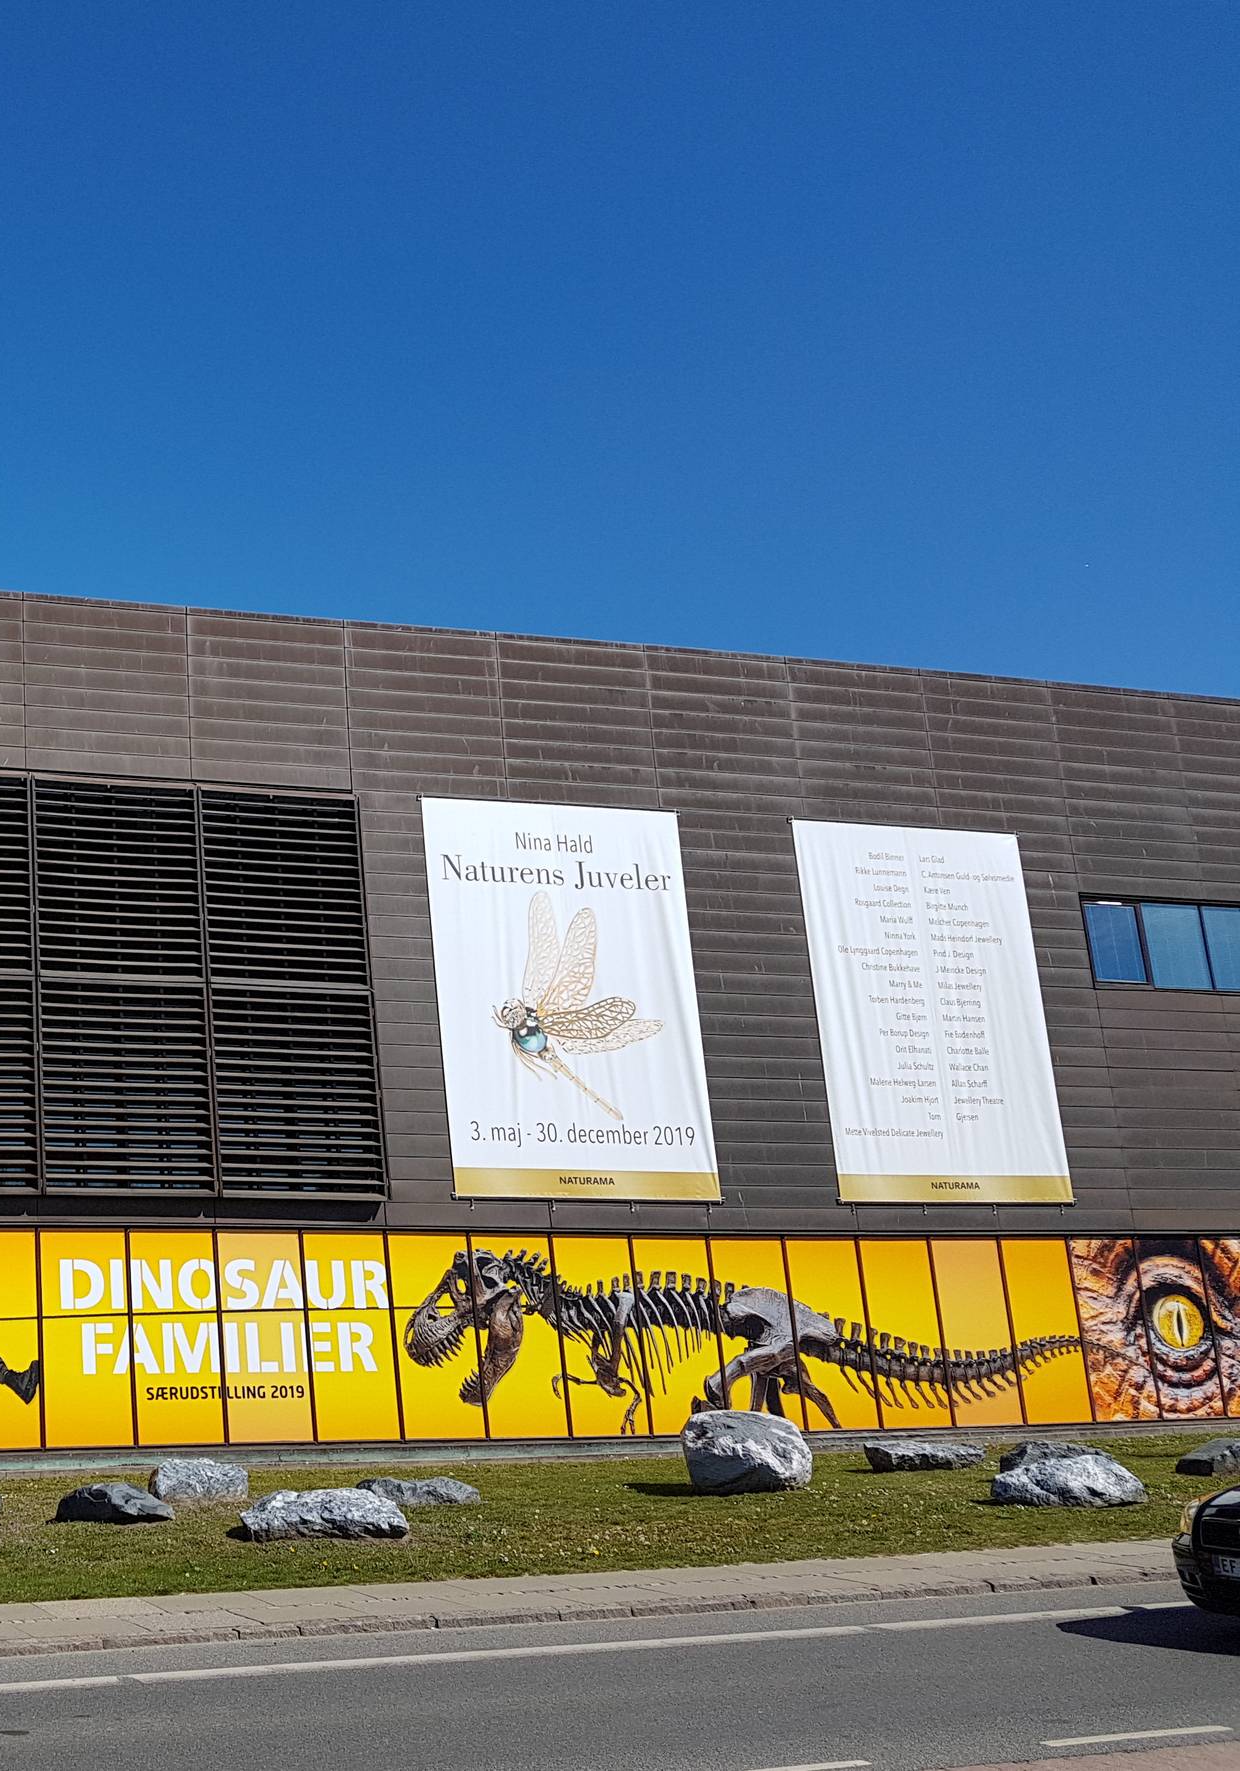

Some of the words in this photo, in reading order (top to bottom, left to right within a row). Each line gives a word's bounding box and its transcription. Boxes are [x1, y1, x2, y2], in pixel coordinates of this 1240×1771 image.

[515, 832, 552, 851] Nina
[557, 834, 593, 854] Hald
[440, 854, 565, 886] Naturens
[574, 860, 671, 891] Juveler
[470, 1121, 486, 1141] 3.
[491, 1123, 522, 1147] maj
[536, 1122, 563, 1143] 30.
[567, 1123, 648, 1145] december
[653, 1126, 695, 1146] 2019
[559, 1176, 615, 1186] NATURAMA
[931, 1181, 980, 1190] NATURAMA
[58, 1258, 390, 1311] DINOSAUR
[81, 1321, 378, 1375] FAMILIER
[146, 1385, 266, 1401] SÆRUDSTILLING
[271, 1385, 305, 1399] 2019
